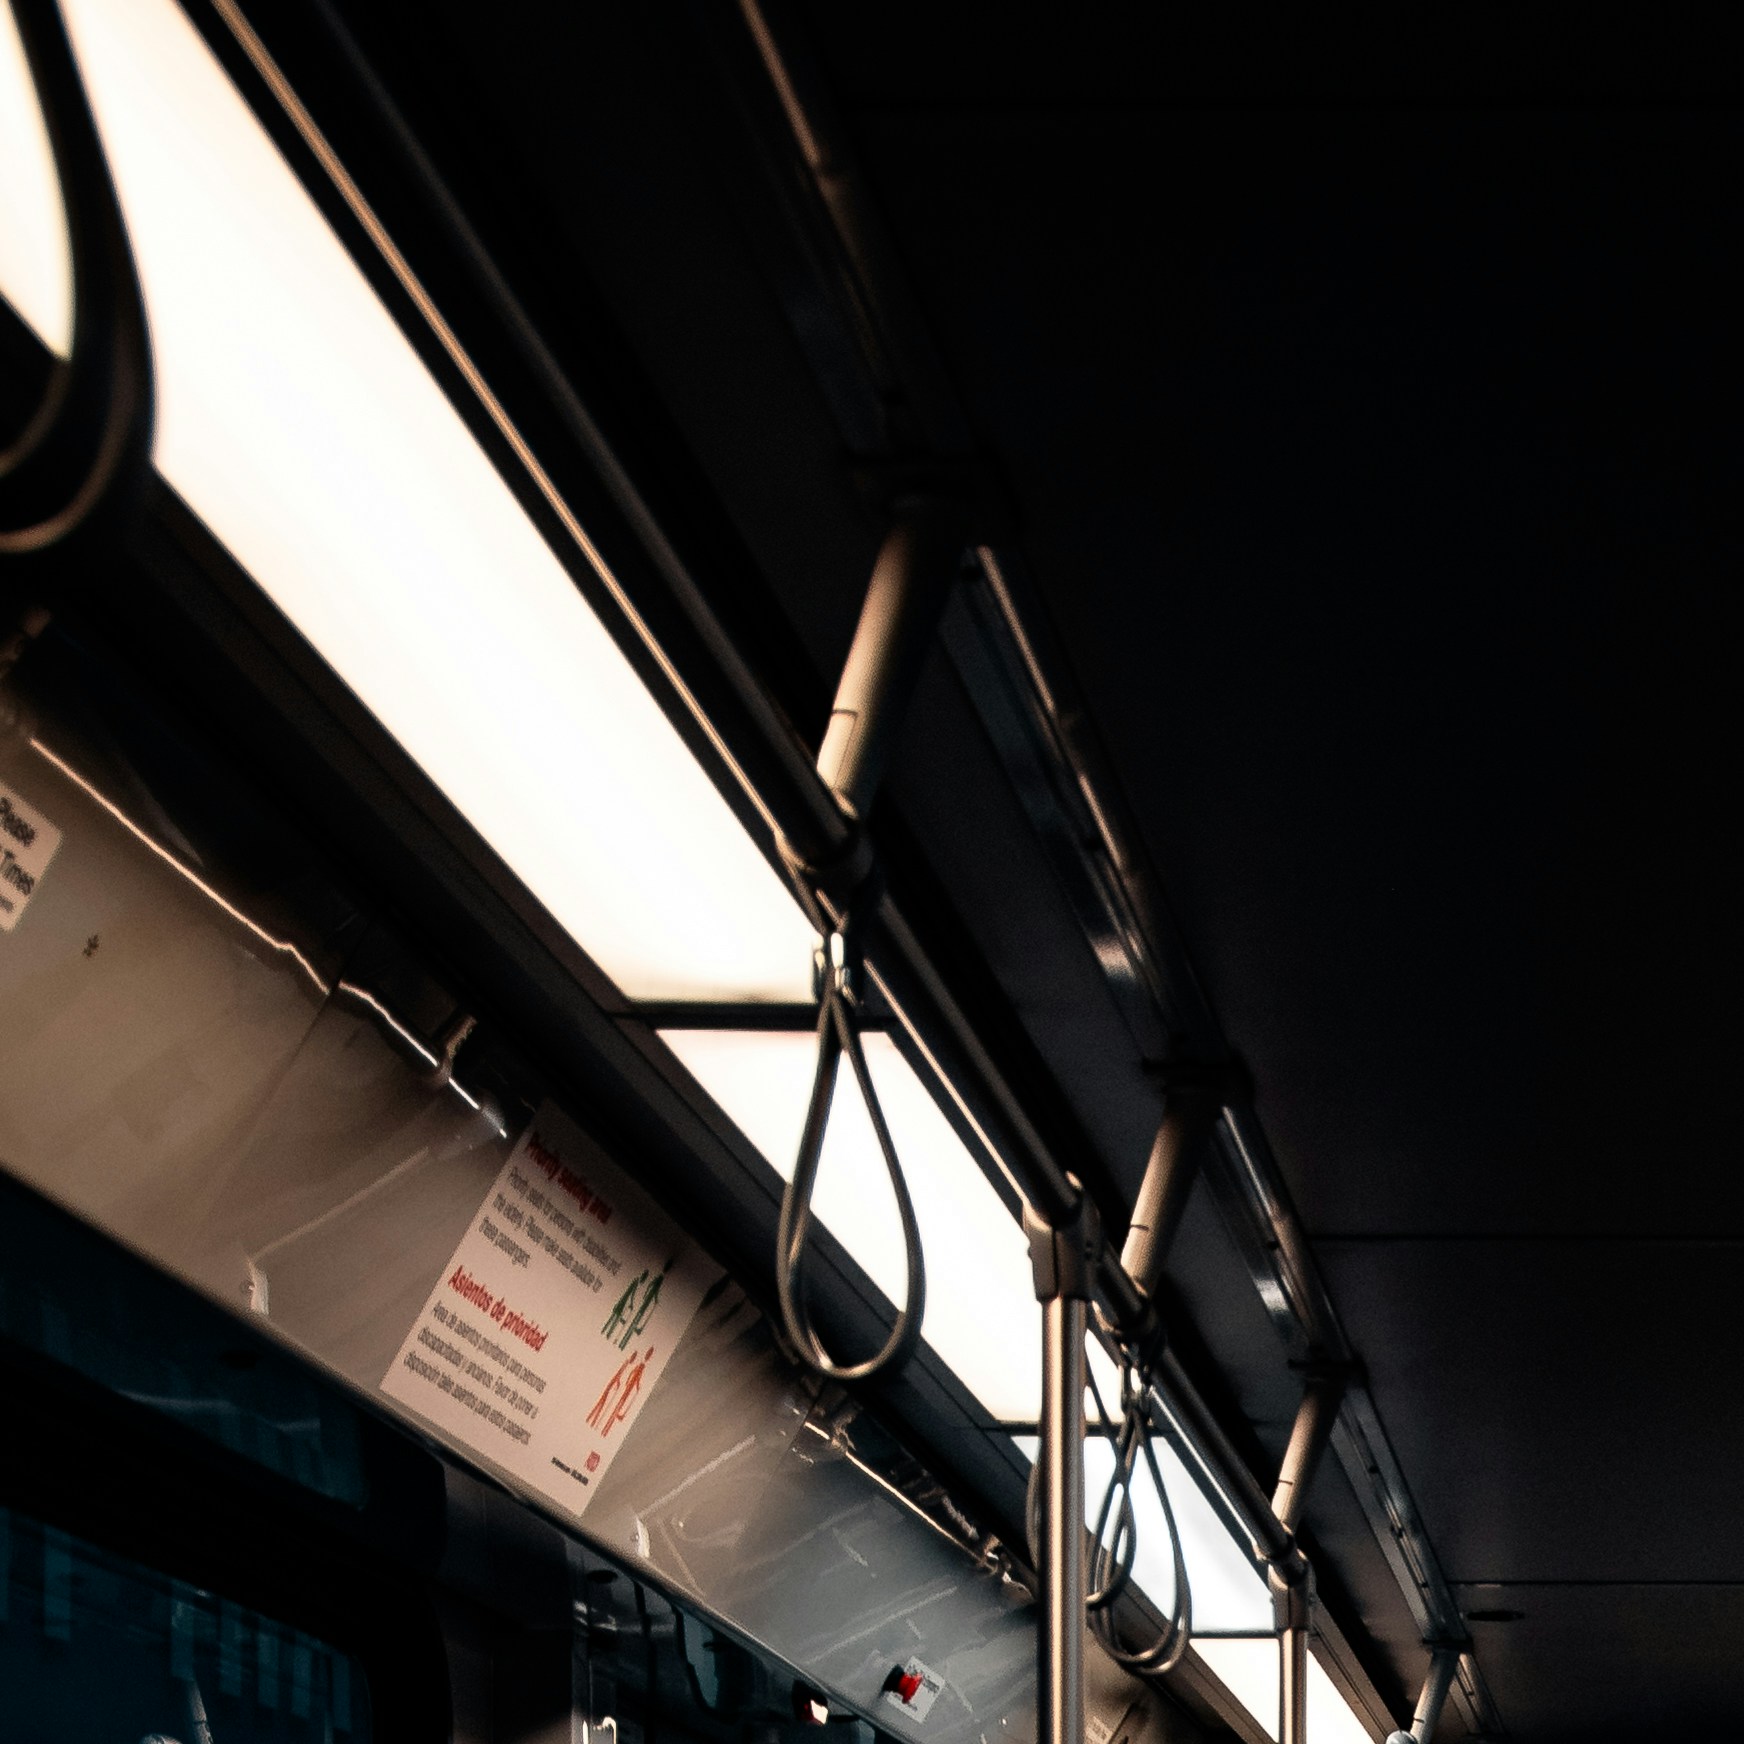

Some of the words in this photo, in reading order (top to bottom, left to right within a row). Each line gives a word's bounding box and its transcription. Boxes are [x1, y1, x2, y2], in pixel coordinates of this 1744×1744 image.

[448, 1266, 493, 1312] Asientos
[490, 1298, 506, 1322] de
[500, 1311, 548, 1351] prioridad
